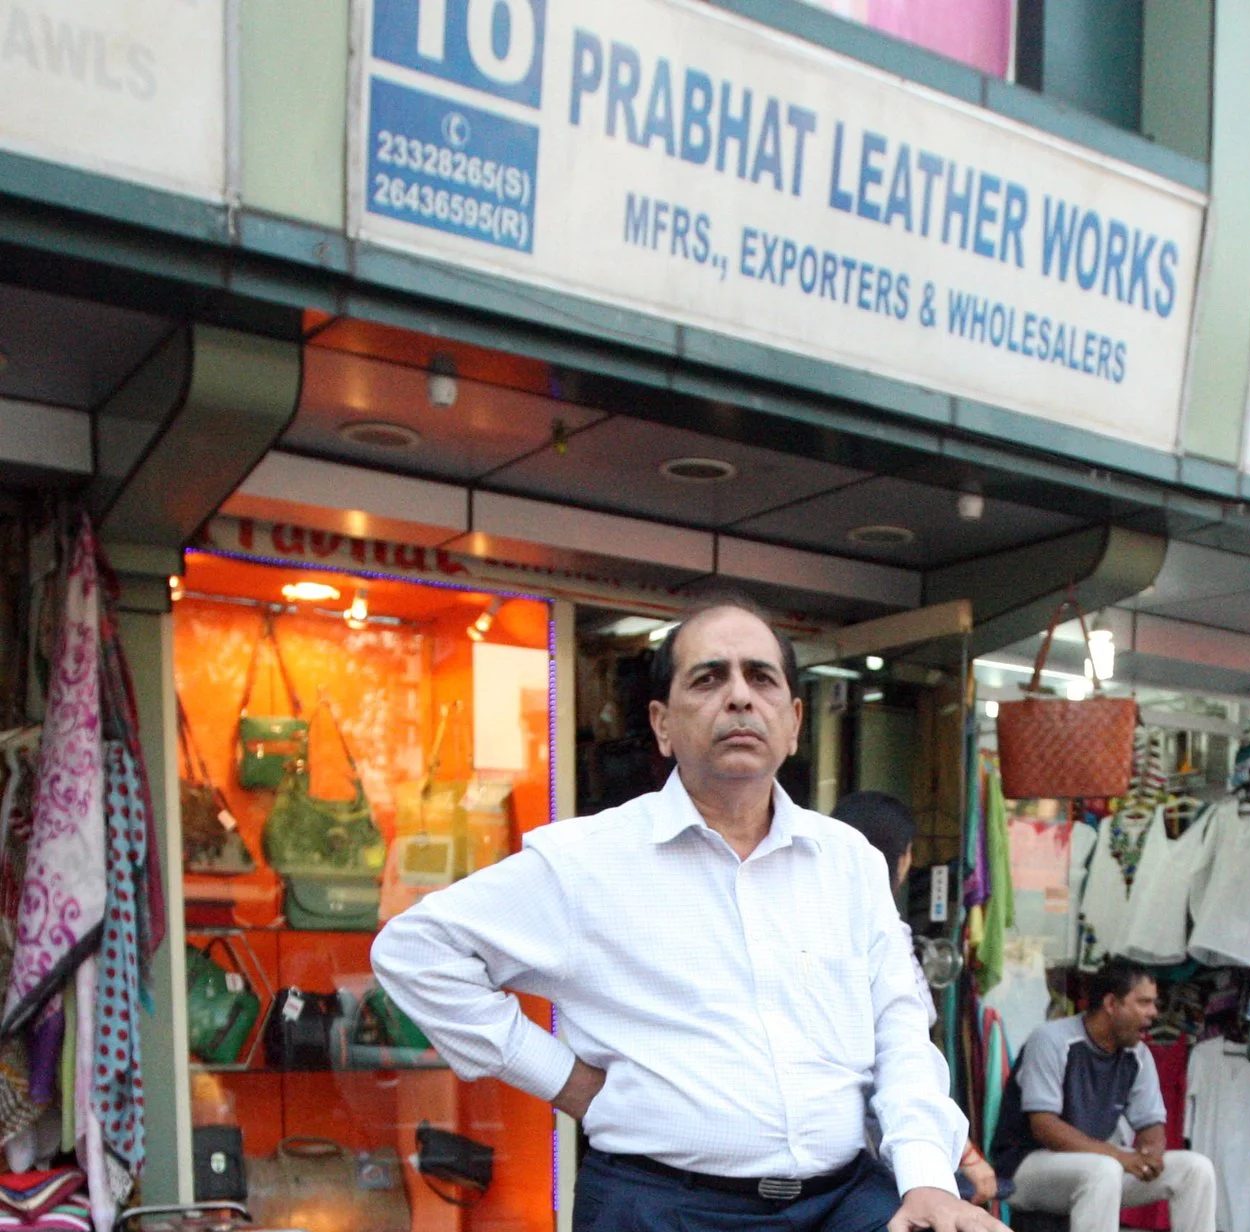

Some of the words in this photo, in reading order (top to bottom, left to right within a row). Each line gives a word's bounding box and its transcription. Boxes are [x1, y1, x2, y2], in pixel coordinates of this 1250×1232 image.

[374, 173, 528, 247] 26436595(R)
[377, 130, 531, 207] 23328265(S)
[568, 25, 818, 198] PRABHAT
[828, 120, 1029, 269] LEATHER
[1041, 193, 1179, 318] WORKS
[623, 191, 728, 282] MFRS.,
[739, 225, 911, 321] EXPORTERS
[919, 281, 937, 328] &
[948, 288, 1127, 384] WHOLESALERS
